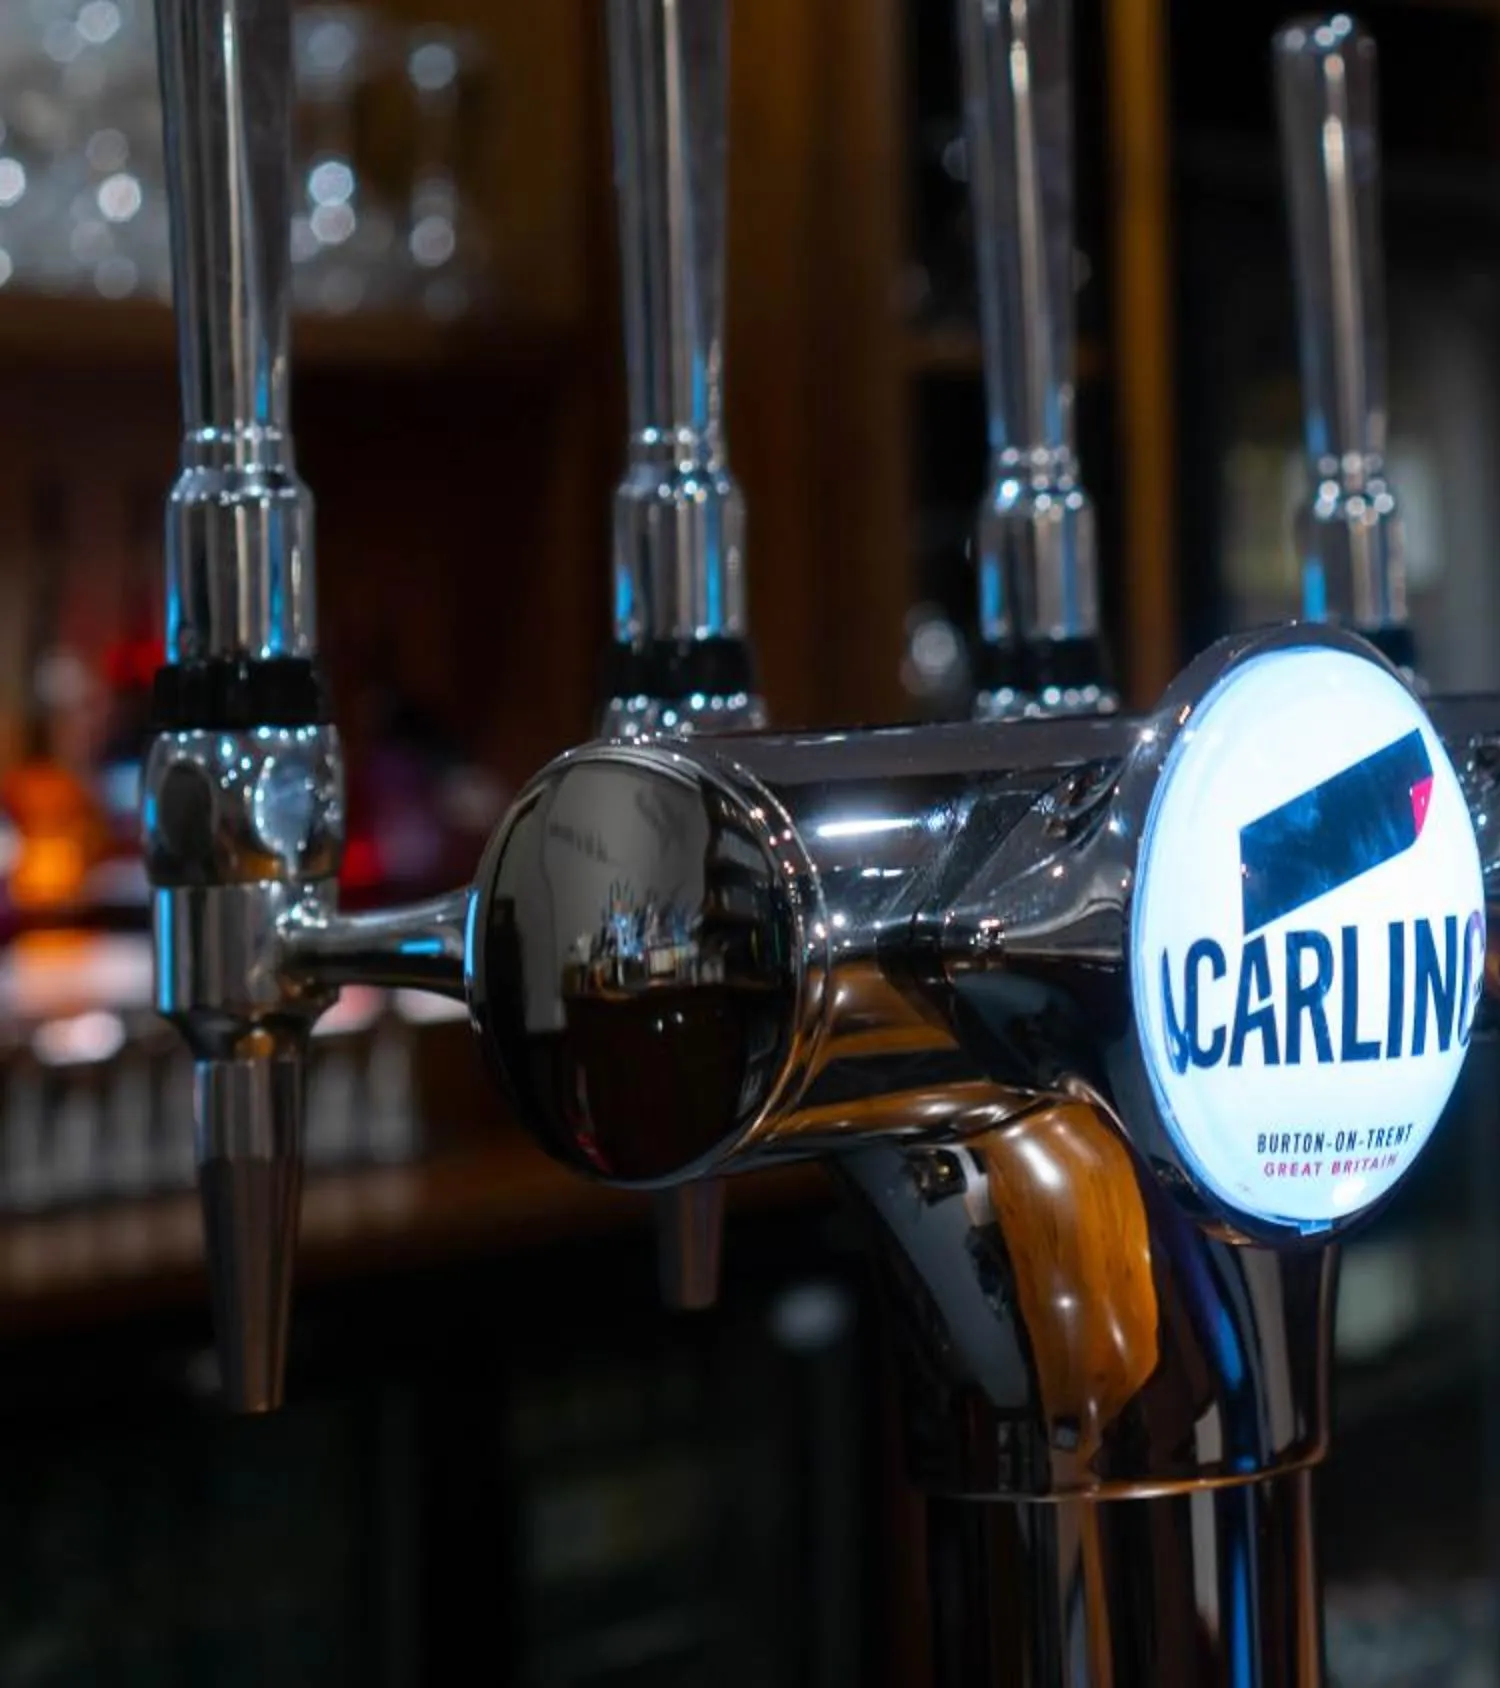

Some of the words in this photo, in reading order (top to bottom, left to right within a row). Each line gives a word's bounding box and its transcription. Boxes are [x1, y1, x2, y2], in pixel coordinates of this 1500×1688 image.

[1256, 1122, 1414, 1155] BURTON-ON-TRENT
[1263, 1159, 1323, 1178] GREAT
[1330, 1151, 1398, 1176] BRITAIN
